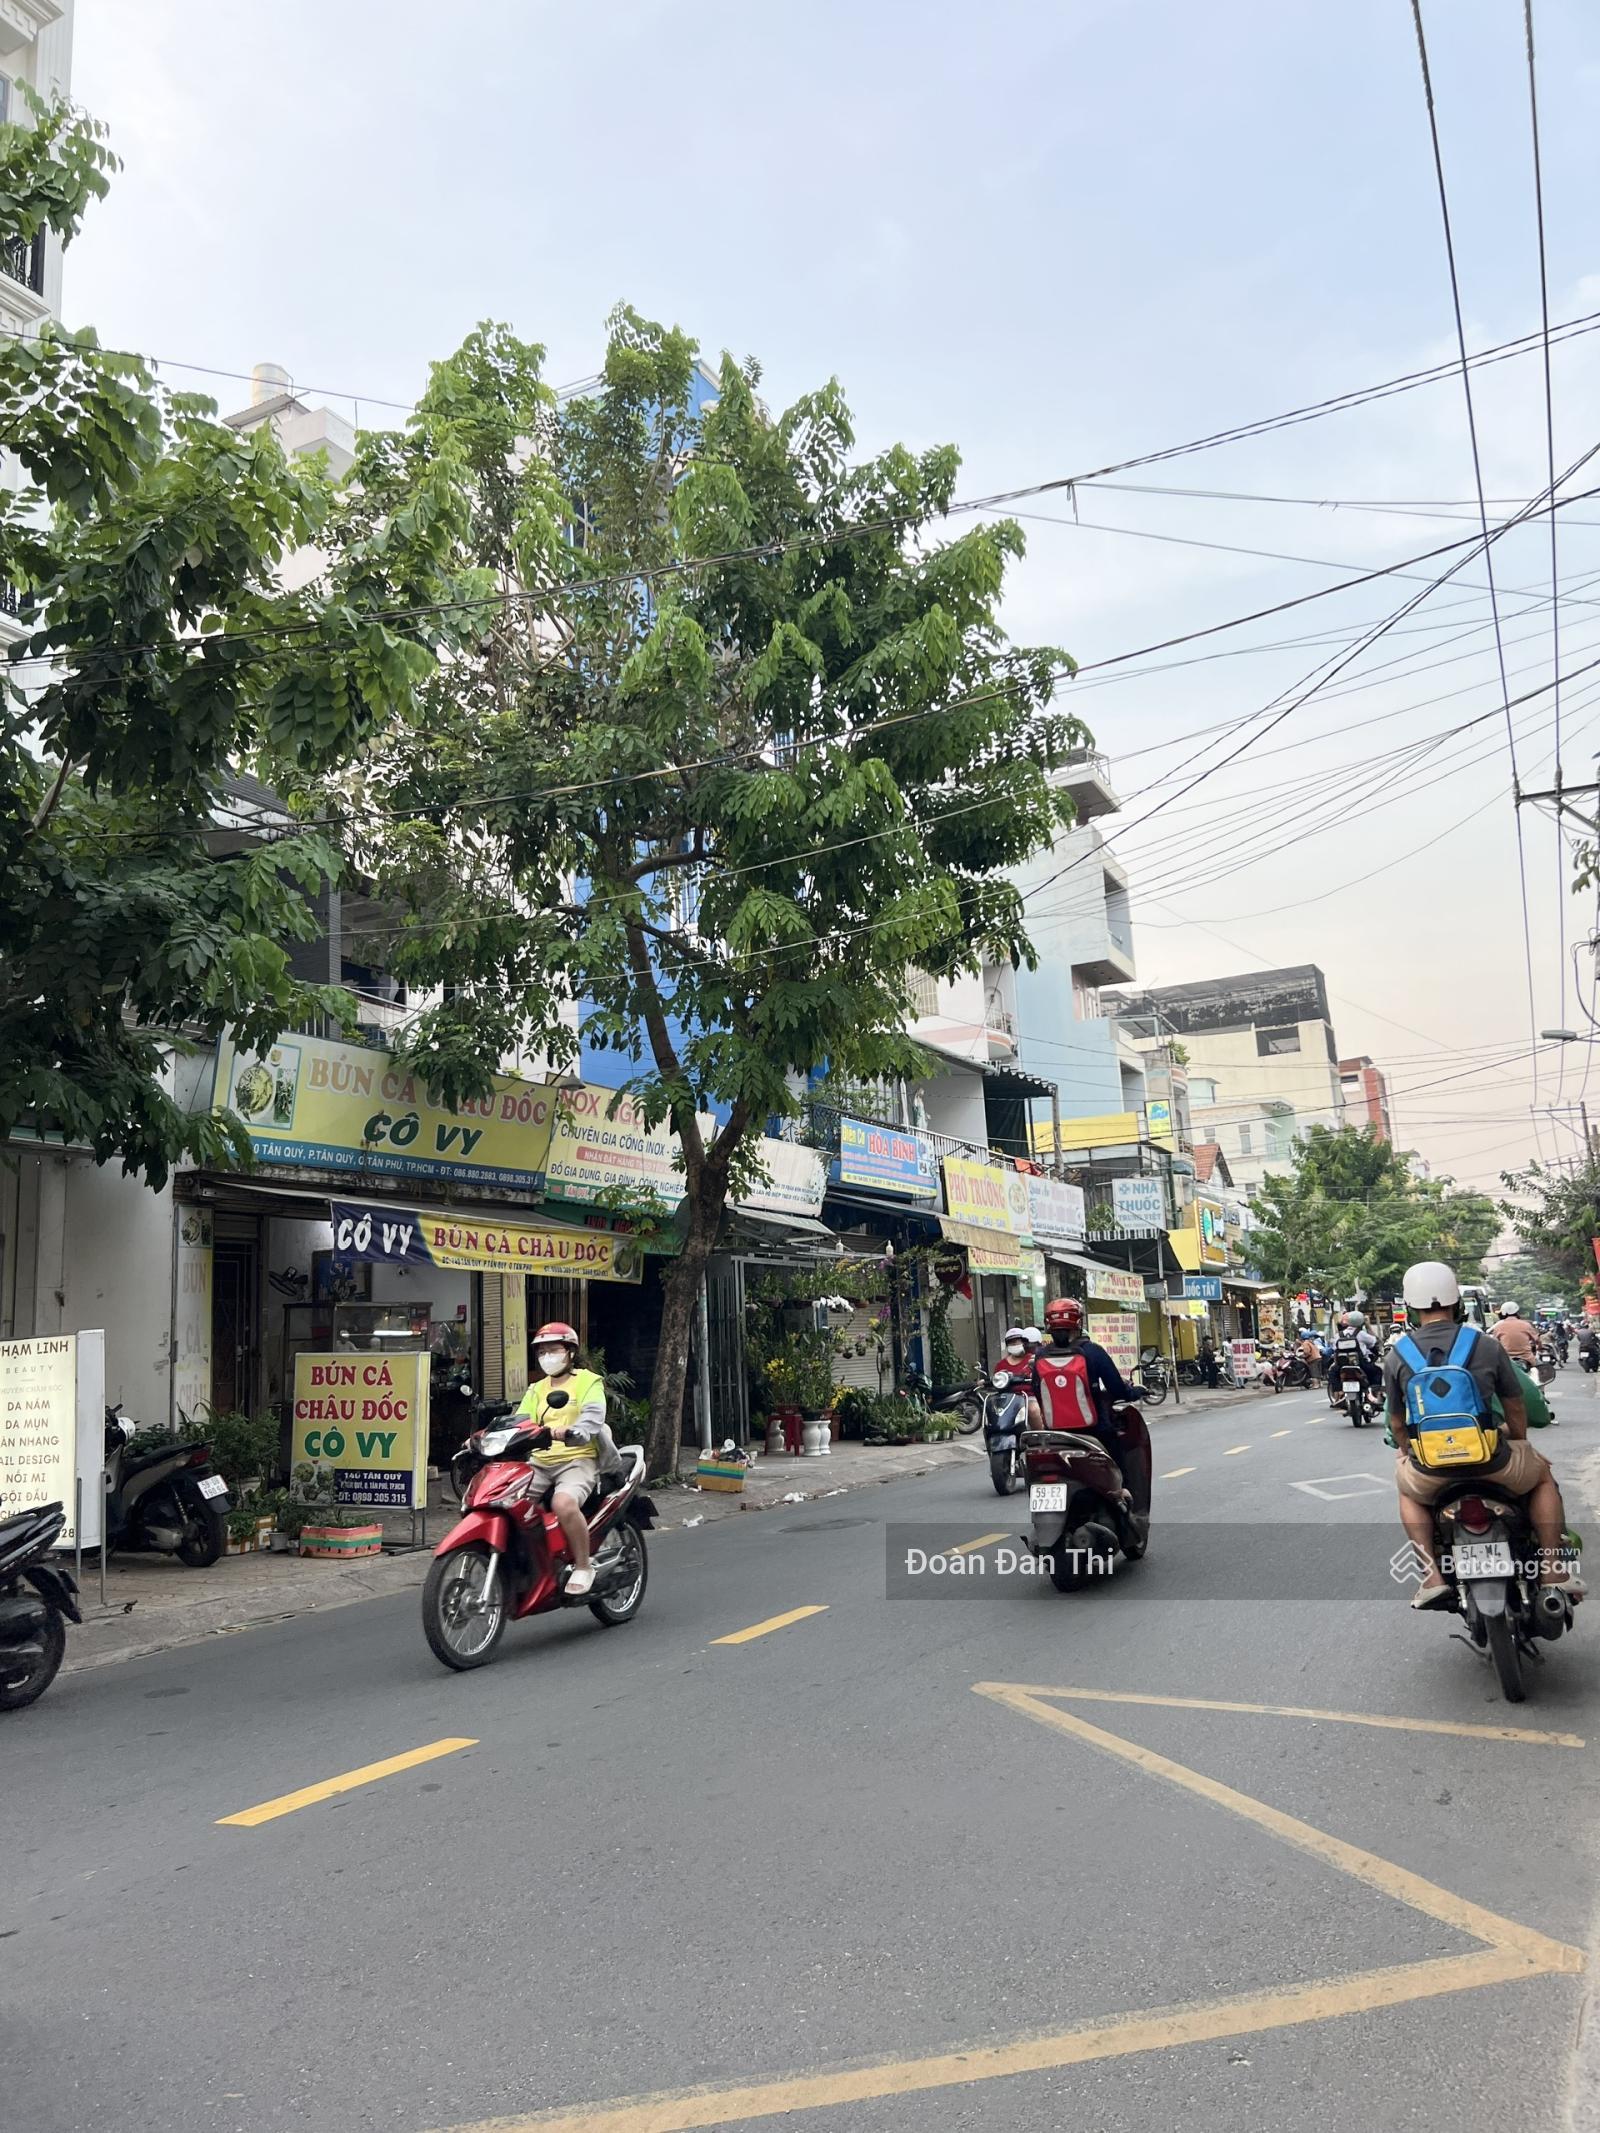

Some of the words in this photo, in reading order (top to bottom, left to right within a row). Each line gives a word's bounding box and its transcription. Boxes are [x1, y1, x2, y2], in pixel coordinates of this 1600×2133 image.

[310, 1053, 375, 1096] BÚN
[500, 1087, 548, 1125] ĐỐC
[364, 1111, 420, 1147] CÔ
[436, 1124, 484, 1156] VY
[262, 1142, 281, 1156] TÂN
[602, 1132, 617, 1146] GIA
[620, 1134, 644, 1152] CÔNG
[646, 1141, 666, 1156] INOX
[564, 1165, 577, 1176] GIA
[604, 1172, 617, 1183] GIA
[1118, 1195, 1161, 1211] THUỐC
[337, 1212, 373, 1252] CÔ
[382, 1223, 413, 1256] VY
[433, 1224, 478, 1250] BÚN
[485, 1229, 511, 1254] CÁ
[518, 1233, 570, 1259] CHÂU
[575, 1236, 609, 1263] ĐỐC
[0, 1342, 32, 1359] HẠM
[36, 1340, 69, 1354] LINH
[6, 1364, 54, 1374] BEAUTY
[310, 1360, 357, 1386] BÚN
[362, 1360, 393, 1386] CÁ
[8, 1401, 22, 1411] DA
[295, 1393, 356, 1420] CHÂU
[361, 1391, 408, 1421] ĐỐC
[5, 1420, 20, 1430] DA
[24, 1418, 49, 1431] MỤN
[0, 1435, 15, 1447] ÀN
[20, 1435, 59, 1446] NHANG
[304, 1426, 345, 1458] CÔ
[355, 1432, 398, 1459] VY
[0, 1456, 15, 1466] AIL
[19, 1454, 60, 1465] DESIGN
[31, 1472, 46, 1483] MI
[363, 1471, 381, 1480] TÂN
[374, 1493, 390, 1503] 305
[391, 1493, 407, 1503] 315
[1035, 1486, 1062, 1498] 59-E2
